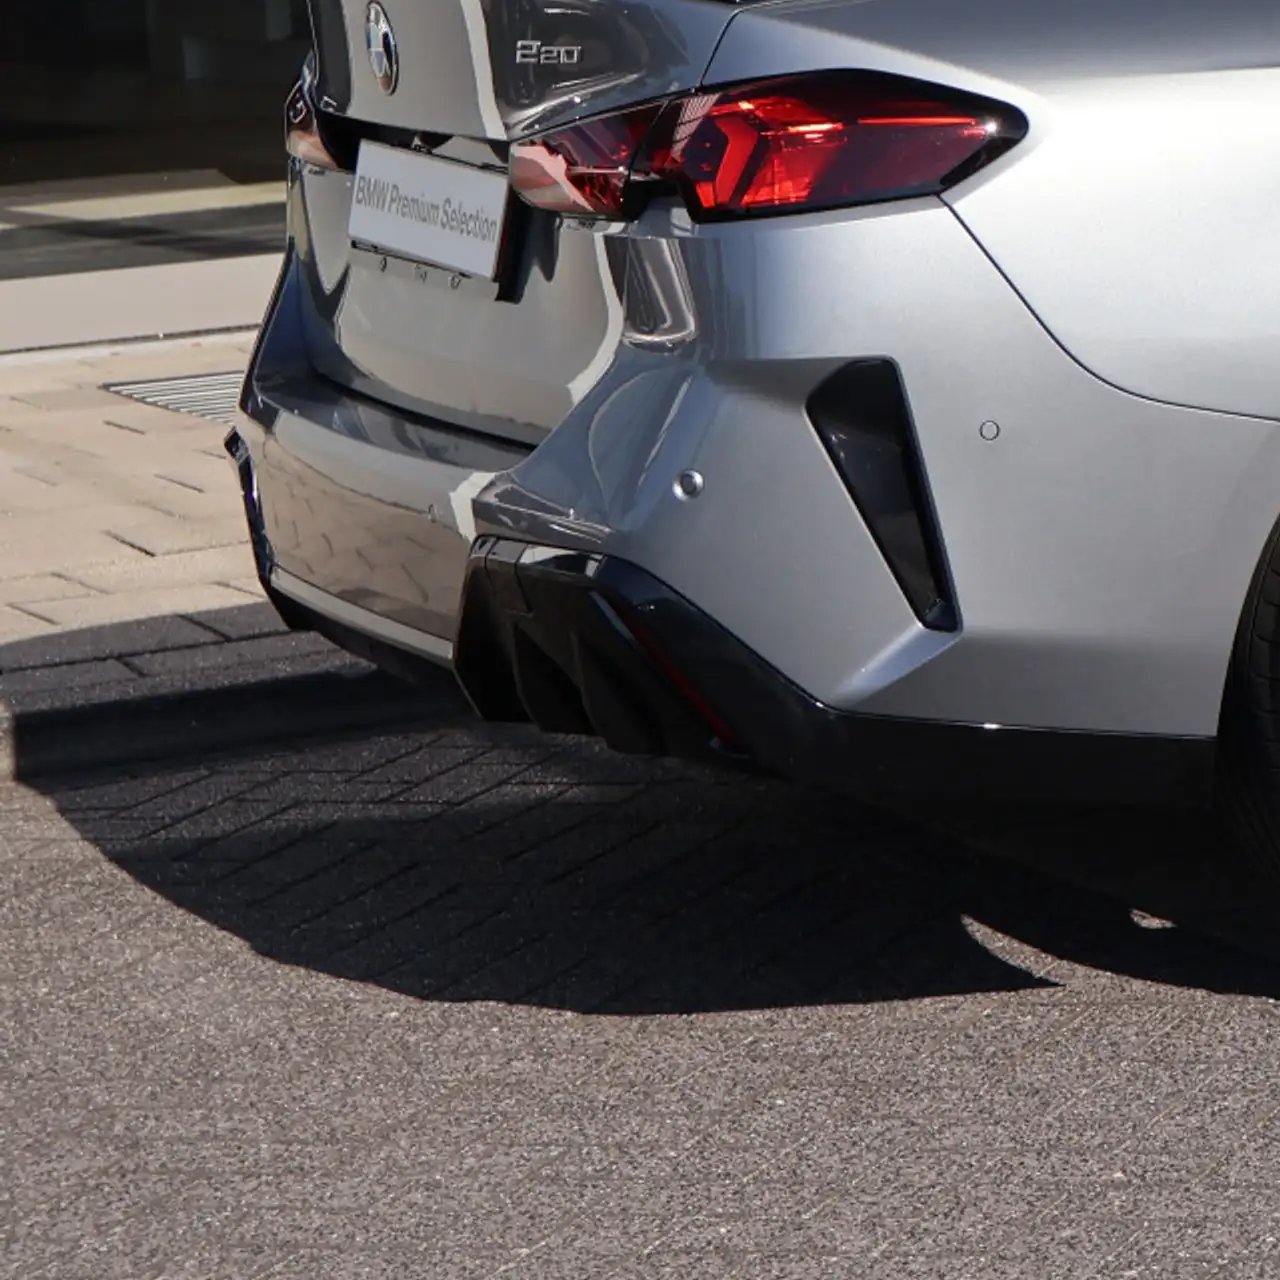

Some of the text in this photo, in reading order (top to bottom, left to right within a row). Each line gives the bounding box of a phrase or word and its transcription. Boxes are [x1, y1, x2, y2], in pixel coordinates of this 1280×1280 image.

[516, 40, 582, 64] 220
[355, 176, 498, 243] BMW Premium Selection
